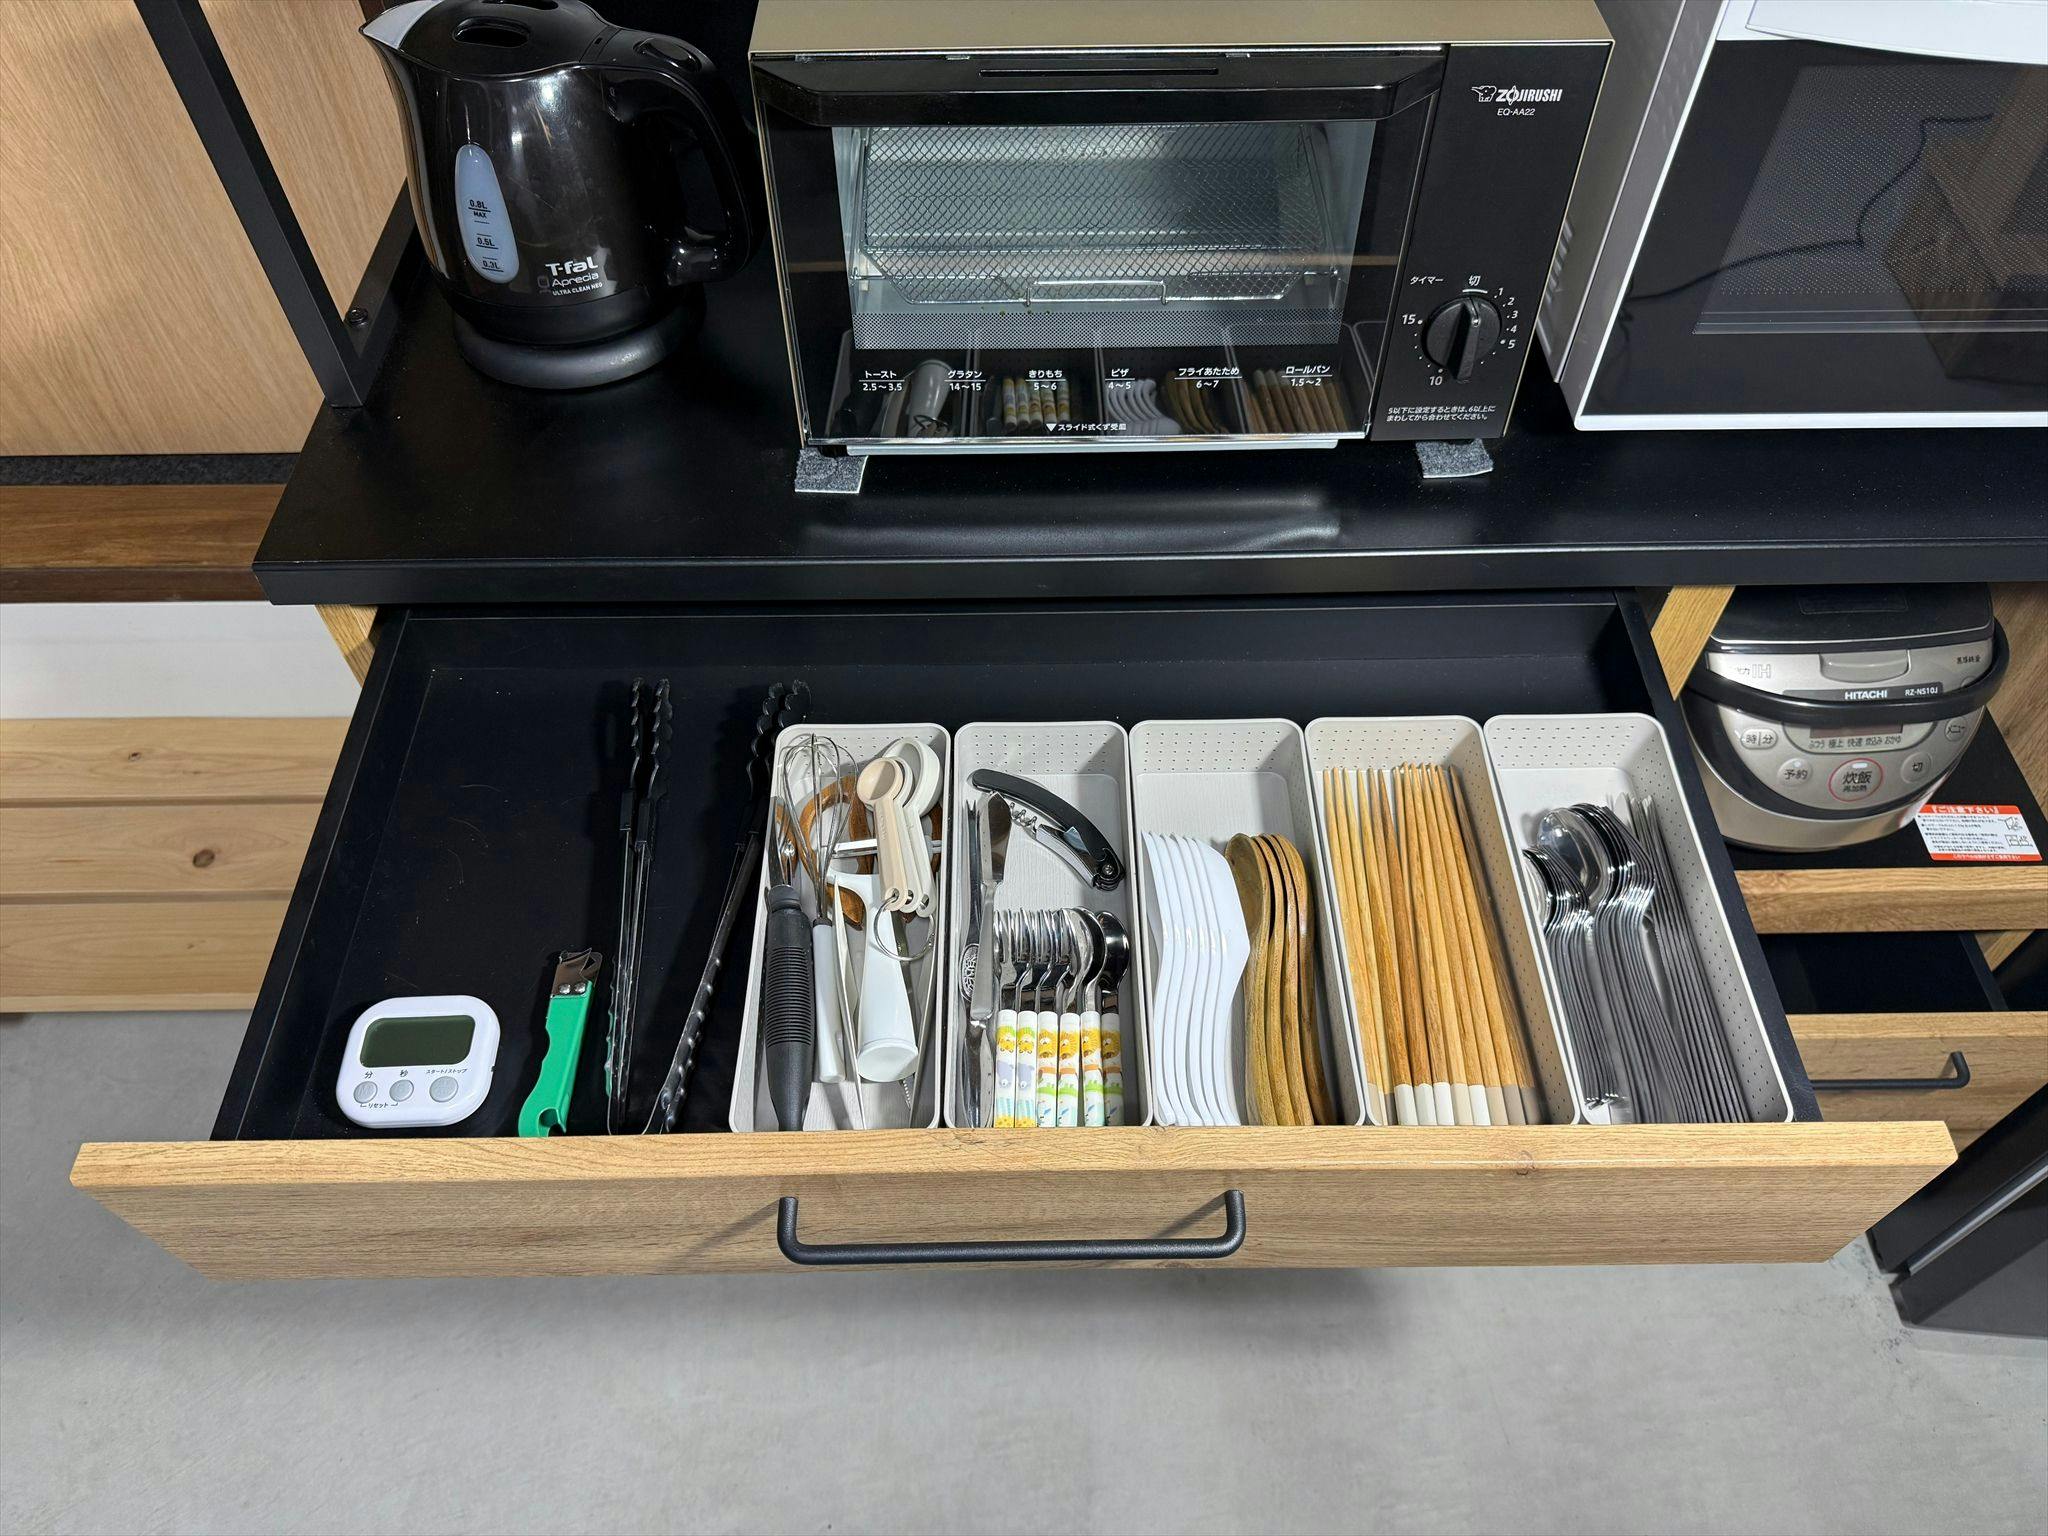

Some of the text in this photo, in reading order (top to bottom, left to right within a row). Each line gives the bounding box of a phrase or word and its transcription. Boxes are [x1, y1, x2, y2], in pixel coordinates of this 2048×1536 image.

[1495, 85, 1563, 106] ZOJIRUSHI
[1497, 108, 1536, 116] EQ-AA22
[469, 199, 488, 210] 0.8L
[473, 211, 487, 219] MAX
[477, 237, 496, 247] 0.5L
[482, 260, 501, 270] 0.3L
[545, 256, 599, 276] T-fal
[552, 272, 599, 287] Aprecia
[1410, 275, 1444, 285] タイマー
[1468, 275, 1481, 286] 切
[552, 287, 571, 296] ULTRA
[572, 285, 591, 293] CLEAN
[1507, 297, 1515, 306] 2
[1402, 314, 1416, 325] 15
[1511, 311, 1519, 319] 3
[1510, 325, 1518, 333] 4
[1507, 339, 1516, 349] 5
[864, 370, 897, 379] トースト
[947, 370, 983, 379] グラタン
[1028, 369, 1063, 379] きりもち
[1111, 368, 1129, 378] ピザ
[1178, 367, 1240, 376] フライあたため
[1285, 365, 1331, 375] ロールパン
[1429, 376, 1443, 386] 10
[1845, 689, 1888, 700] HITACHI
[1905, 687, 1938, 697] RZ-NS10J
[1746, 734, 1758, 744] 時
[1762, 734, 1774, 744] 分
[1912, 762, 1923, 773] 切
[1784, 769, 1808, 780] 予約
[1843, 770, 1872, 784] 炊飯
[364, 1071, 373, 1079] 分
